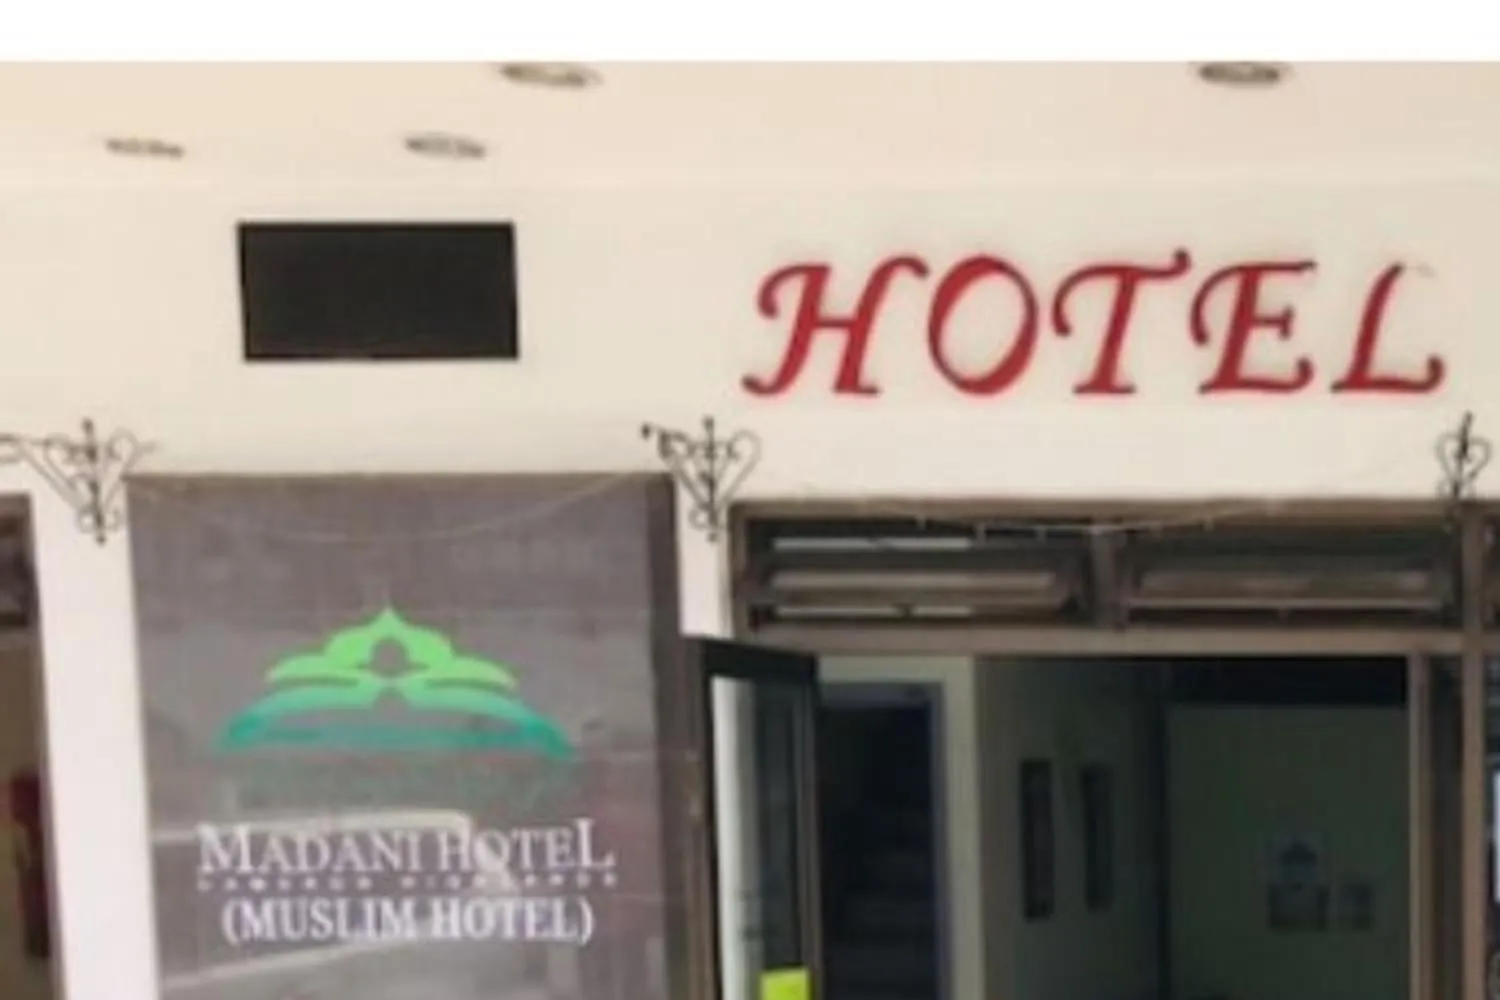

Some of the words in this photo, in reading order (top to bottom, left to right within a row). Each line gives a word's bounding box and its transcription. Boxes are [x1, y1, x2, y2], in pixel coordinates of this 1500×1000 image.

[742, 250, 1446, 397] HOTEL
[200, 822, 423, 874] MADANI
[437, 817, 618, 872] HOTEL
[221, 896, 417, 945] (MUSLIM
[432, 896, 596, 945] HOTEL)
